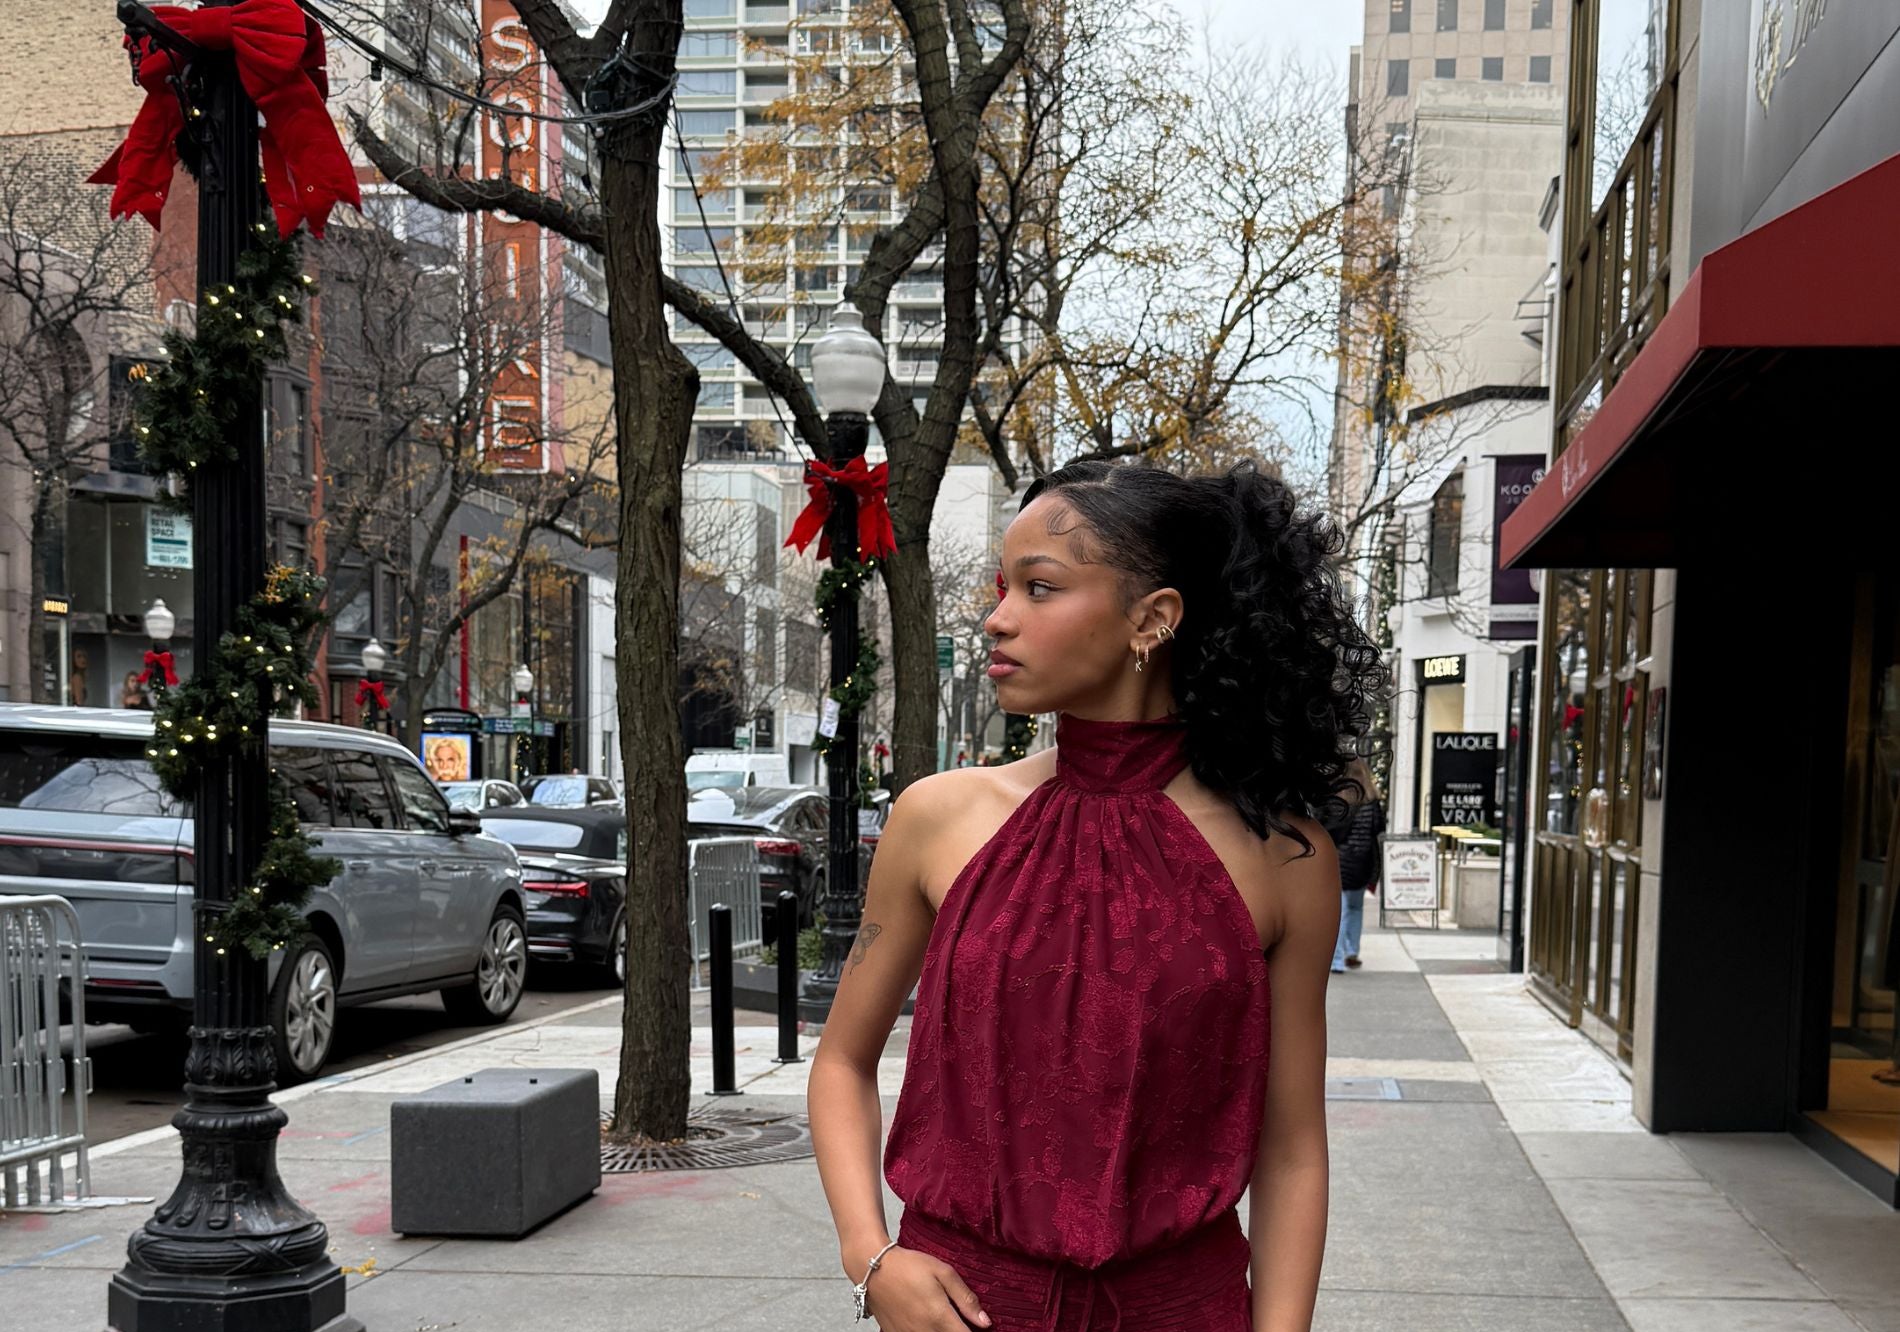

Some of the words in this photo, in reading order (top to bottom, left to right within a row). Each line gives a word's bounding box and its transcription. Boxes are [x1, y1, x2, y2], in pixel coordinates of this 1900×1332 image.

[1424, 656, 1460, 678] LOEWE
[1436, 735, 1495, 751] LALIQUE
[1441, 794, 1455, 804] LE
[1441, 809, 1485, 823] VRAI
